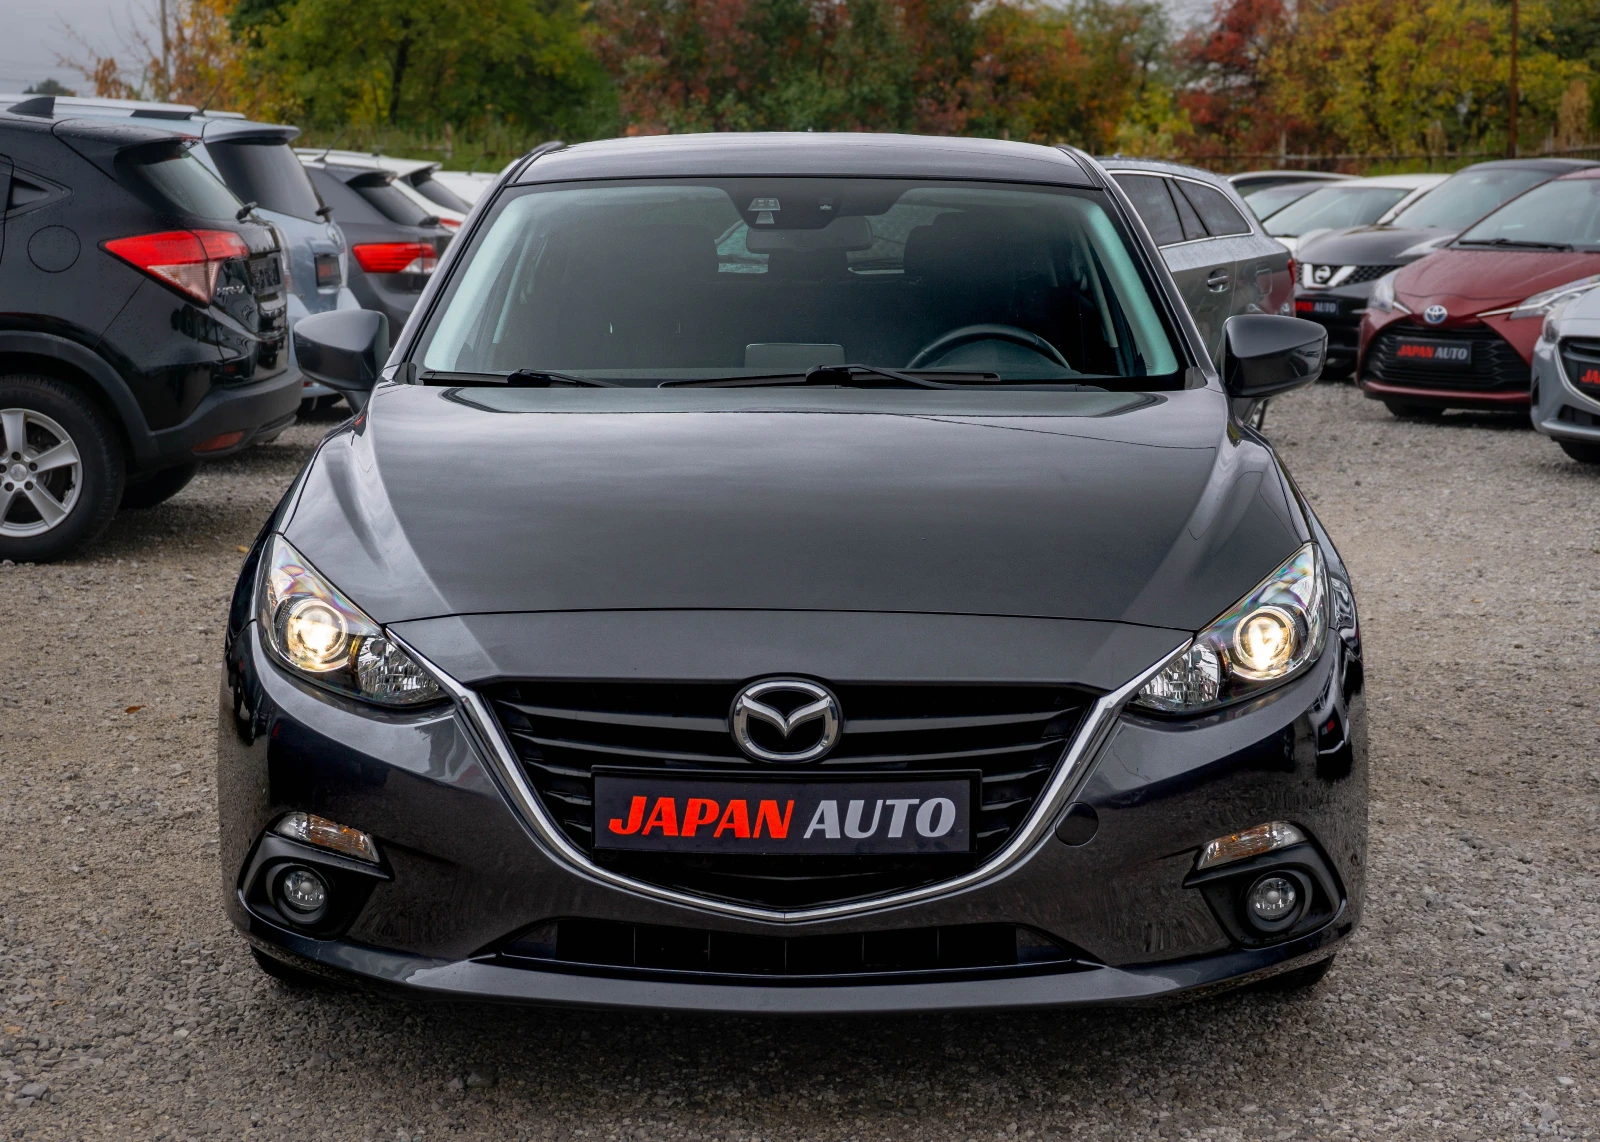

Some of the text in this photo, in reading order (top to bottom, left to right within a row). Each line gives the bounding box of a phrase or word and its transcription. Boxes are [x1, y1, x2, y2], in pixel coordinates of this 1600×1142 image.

[1314, 301, 1337, 313] AUTO
[1397, 344, 1468, 360] JAPAN AUTO
[608, 796, 956, 839] JAPAN AUTO
